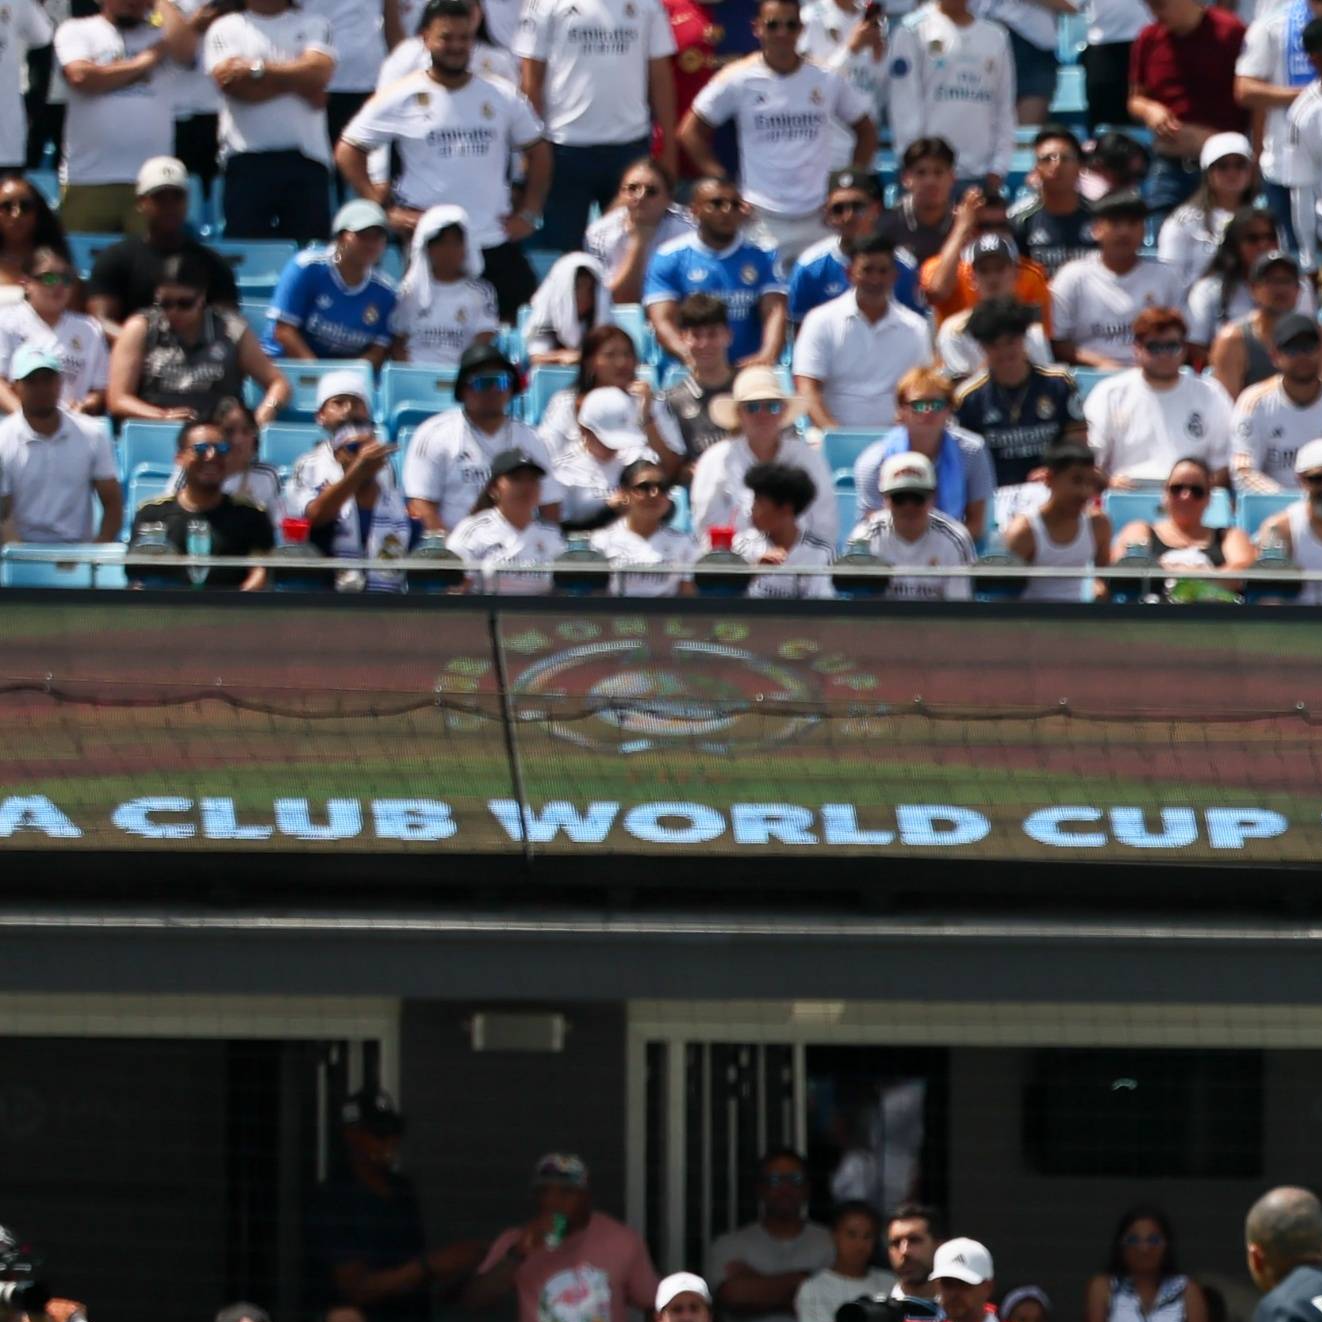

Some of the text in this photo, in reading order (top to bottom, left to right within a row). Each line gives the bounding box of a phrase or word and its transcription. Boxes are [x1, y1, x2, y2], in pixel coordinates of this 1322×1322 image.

[112, 796, 457, 841] CLUB
[488, 799, 991, 846] WORLD
[1023, 806, 1288, 849] CUP
